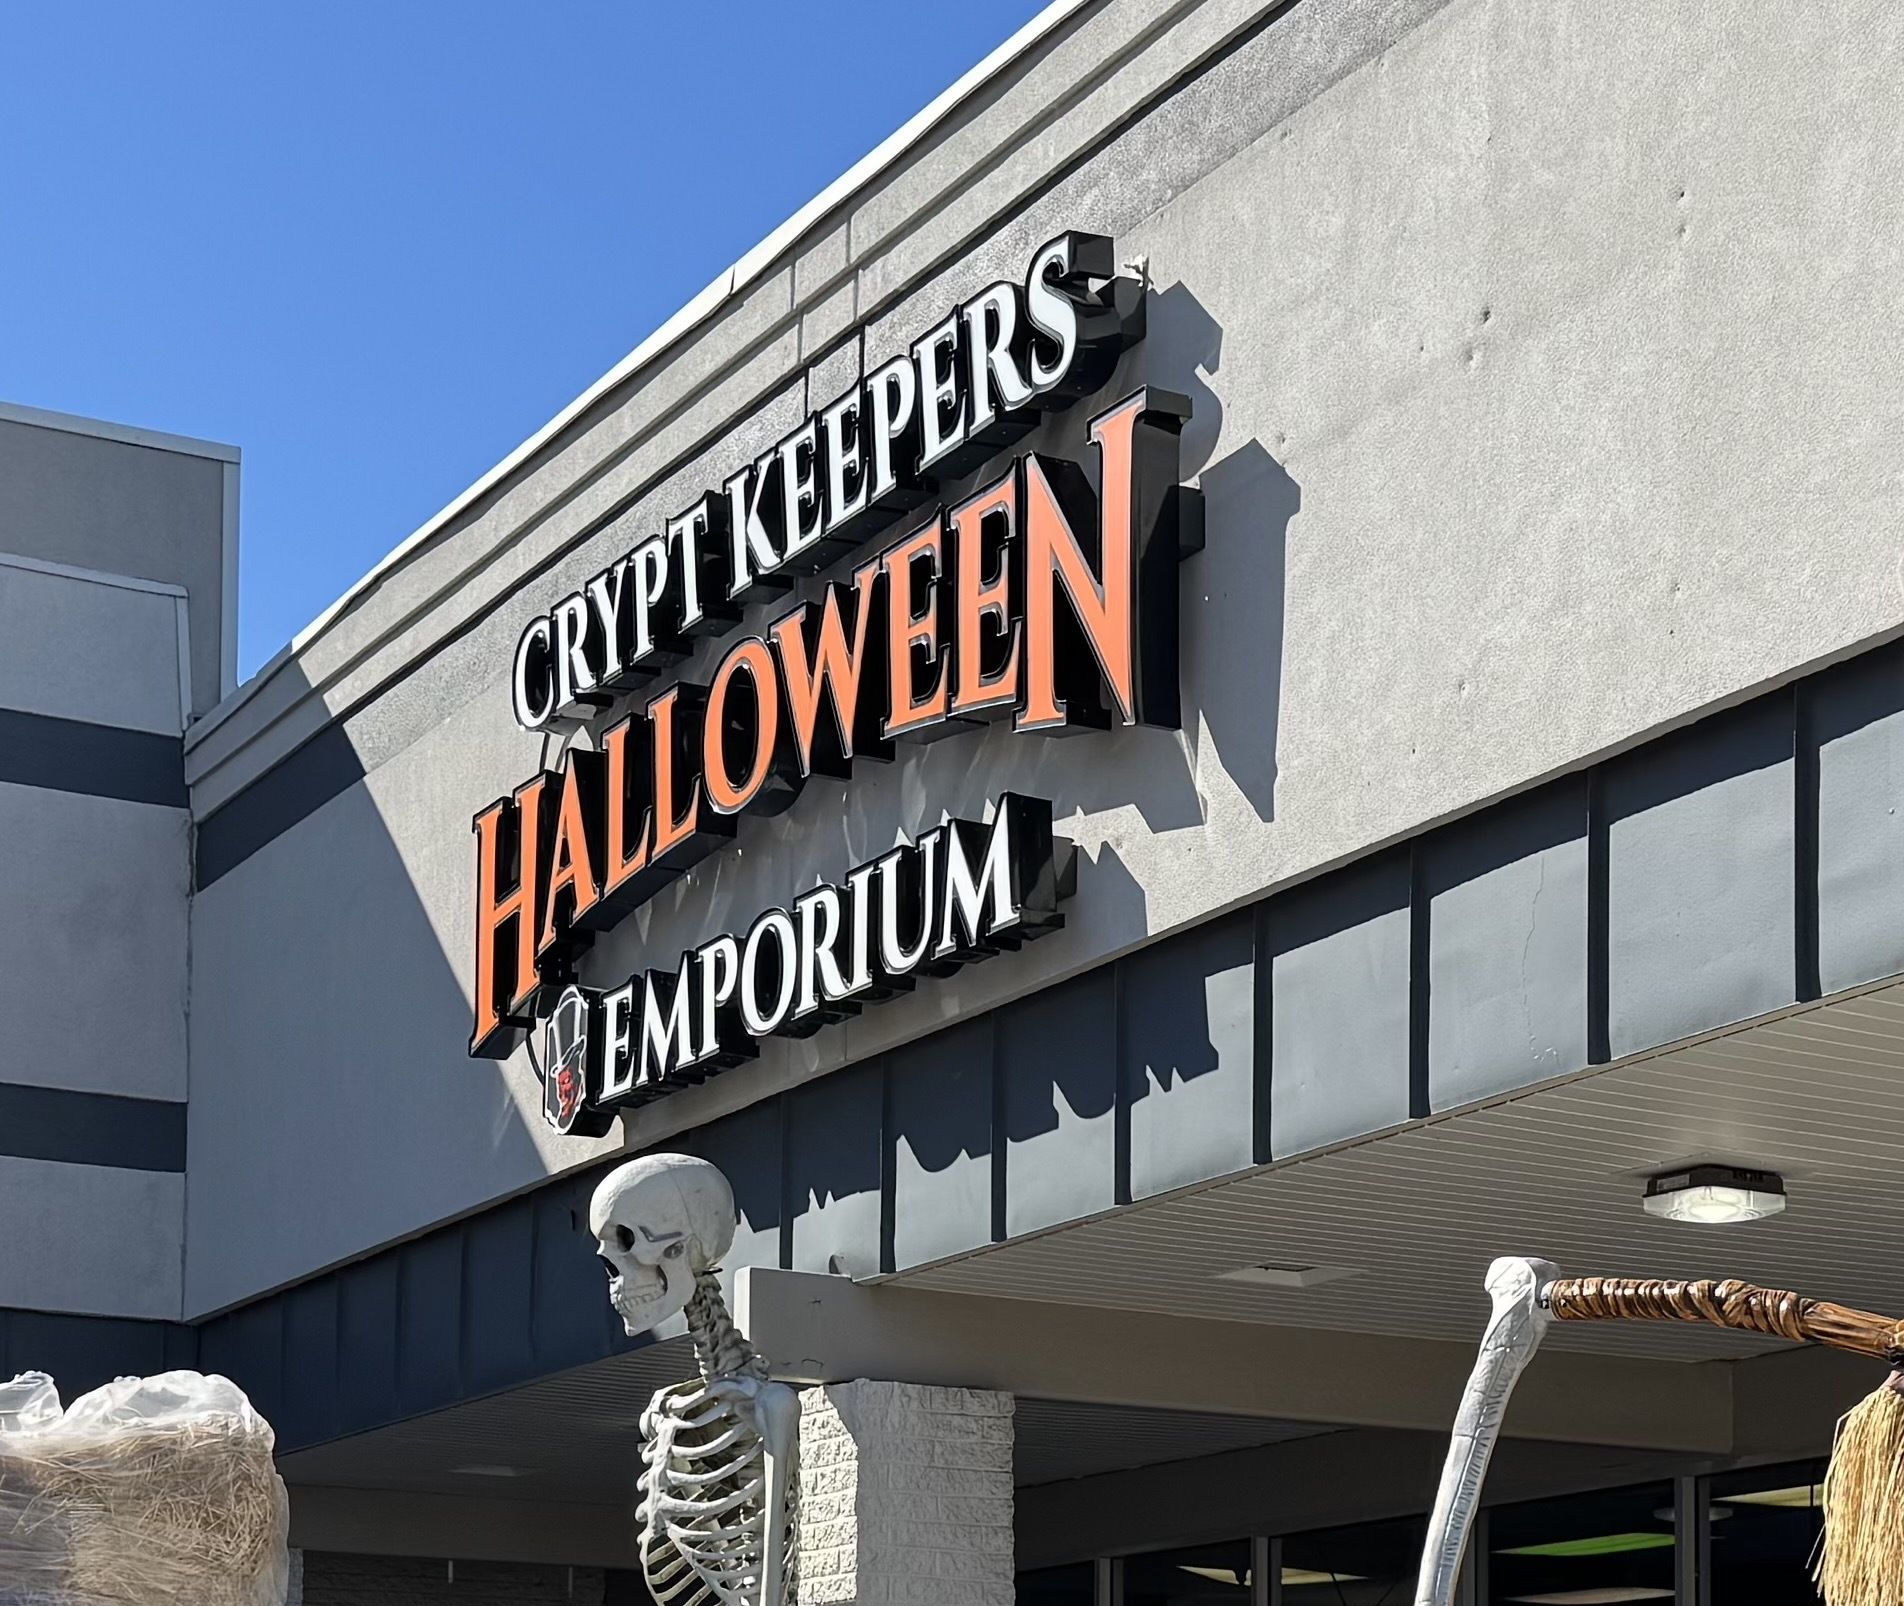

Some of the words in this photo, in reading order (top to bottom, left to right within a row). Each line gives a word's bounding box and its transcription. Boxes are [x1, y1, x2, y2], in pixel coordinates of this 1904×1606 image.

[470, 392, 1148, 1058] HALLOWEEN
[513, 495, 718, 733] CRYPT
[726, 234, 1081, 600] KEEPERS
[597, 797, 1026, 1104] EMPORIUM
